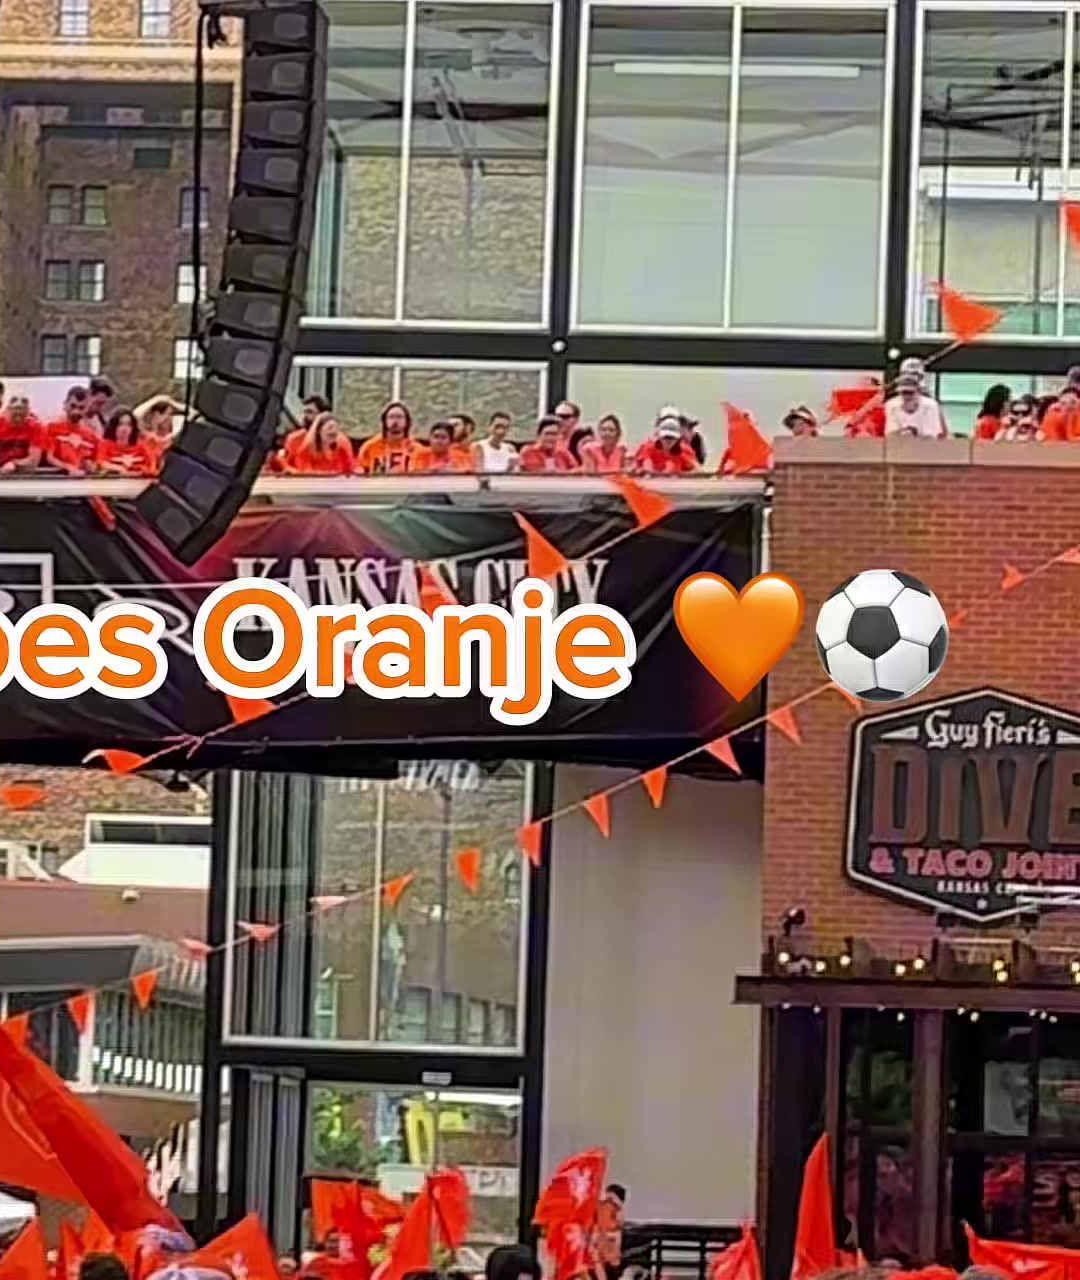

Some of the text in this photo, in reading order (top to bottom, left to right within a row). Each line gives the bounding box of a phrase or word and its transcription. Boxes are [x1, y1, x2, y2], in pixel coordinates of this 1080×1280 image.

[925, 709, 979, 748] Guy
[869, 847, 1080, 881] & TACO JOIN
